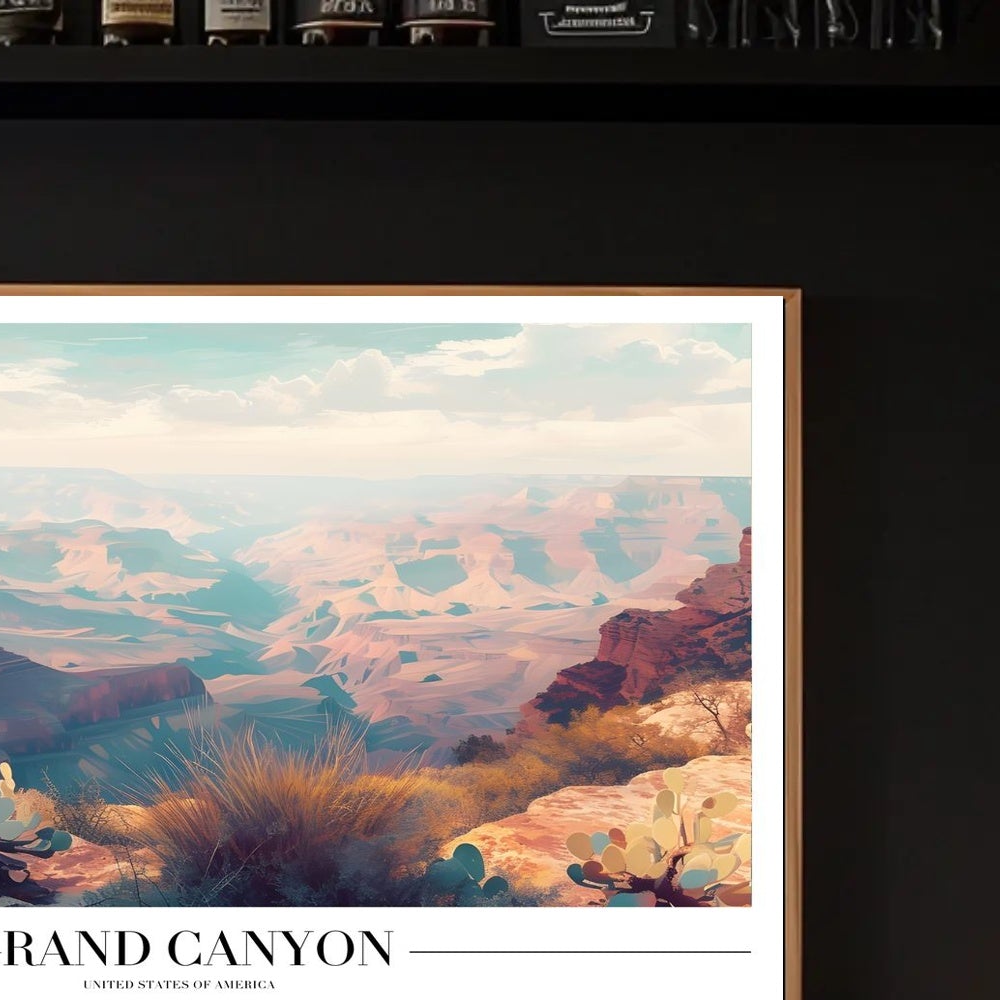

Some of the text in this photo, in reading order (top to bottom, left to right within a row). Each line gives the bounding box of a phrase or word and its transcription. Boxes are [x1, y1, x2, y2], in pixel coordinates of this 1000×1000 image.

[167, 929, 395, 967] CANYON
[83, 980, 276, 990] UNITED STATES OF AMERICA
